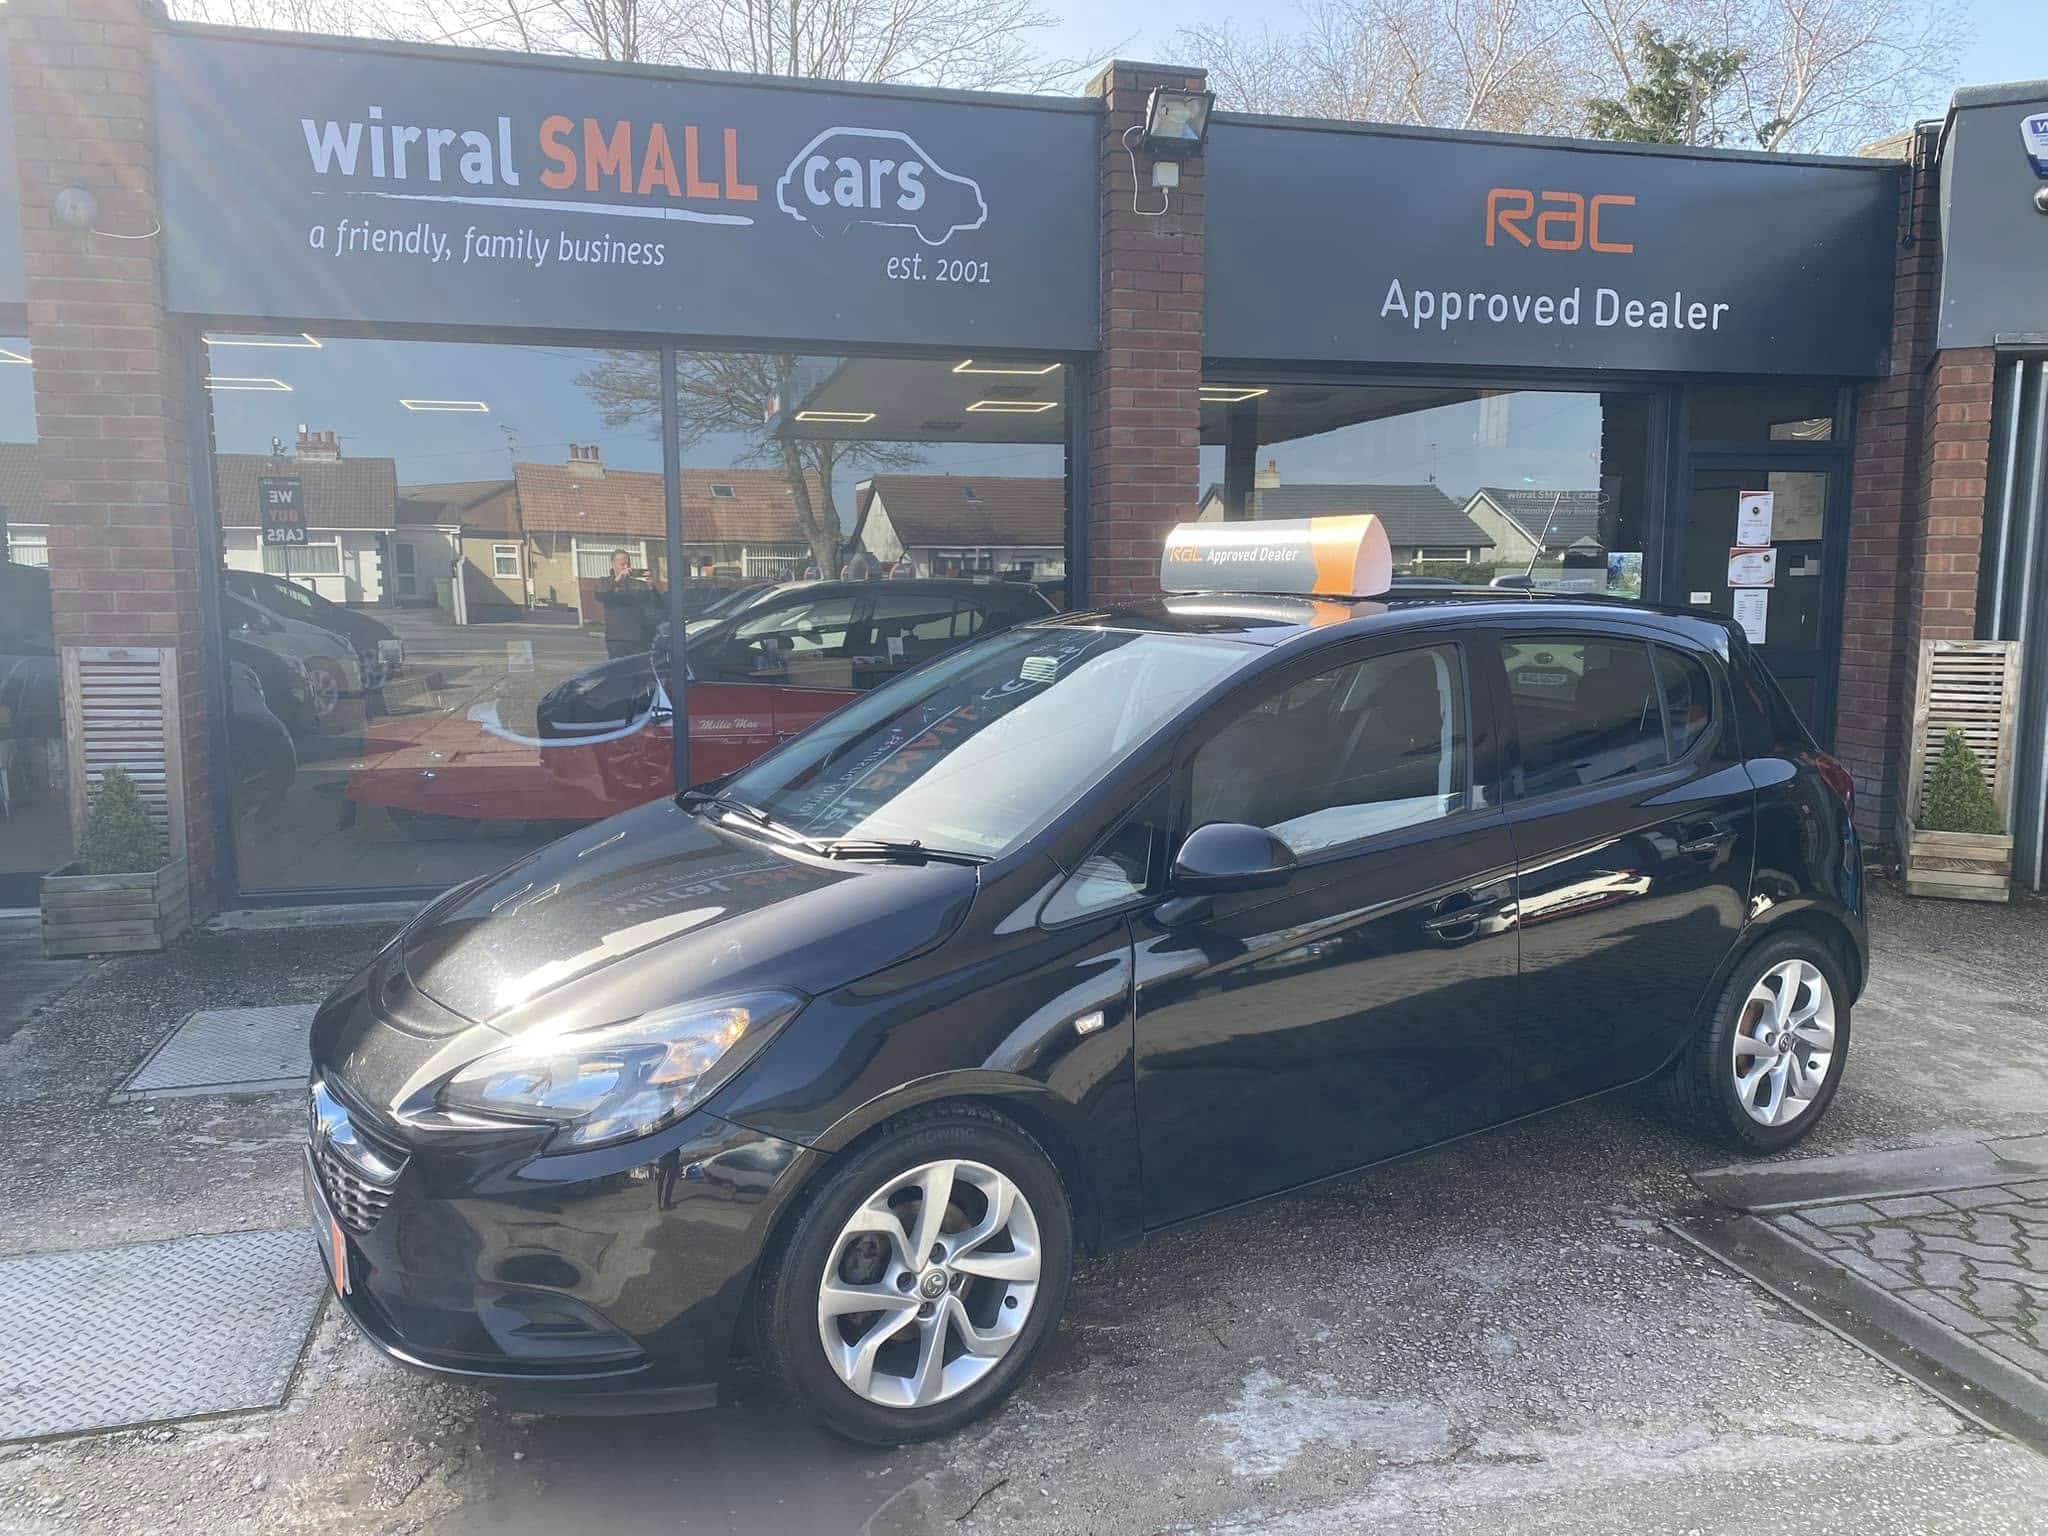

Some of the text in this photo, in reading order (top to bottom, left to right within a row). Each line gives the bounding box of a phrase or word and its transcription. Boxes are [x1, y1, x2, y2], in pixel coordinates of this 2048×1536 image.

[301, 106, 926, 211] wirral SMALL cars
[309, 219, 665, 268] a friendly, family business
[887, 253, 991, 283] est. 2001
[1380, 278, 1730, 331] Approved Dealer
[1207, 547, 1258, 565] Approved
[1259, 547, 1298, 561] Dealer
